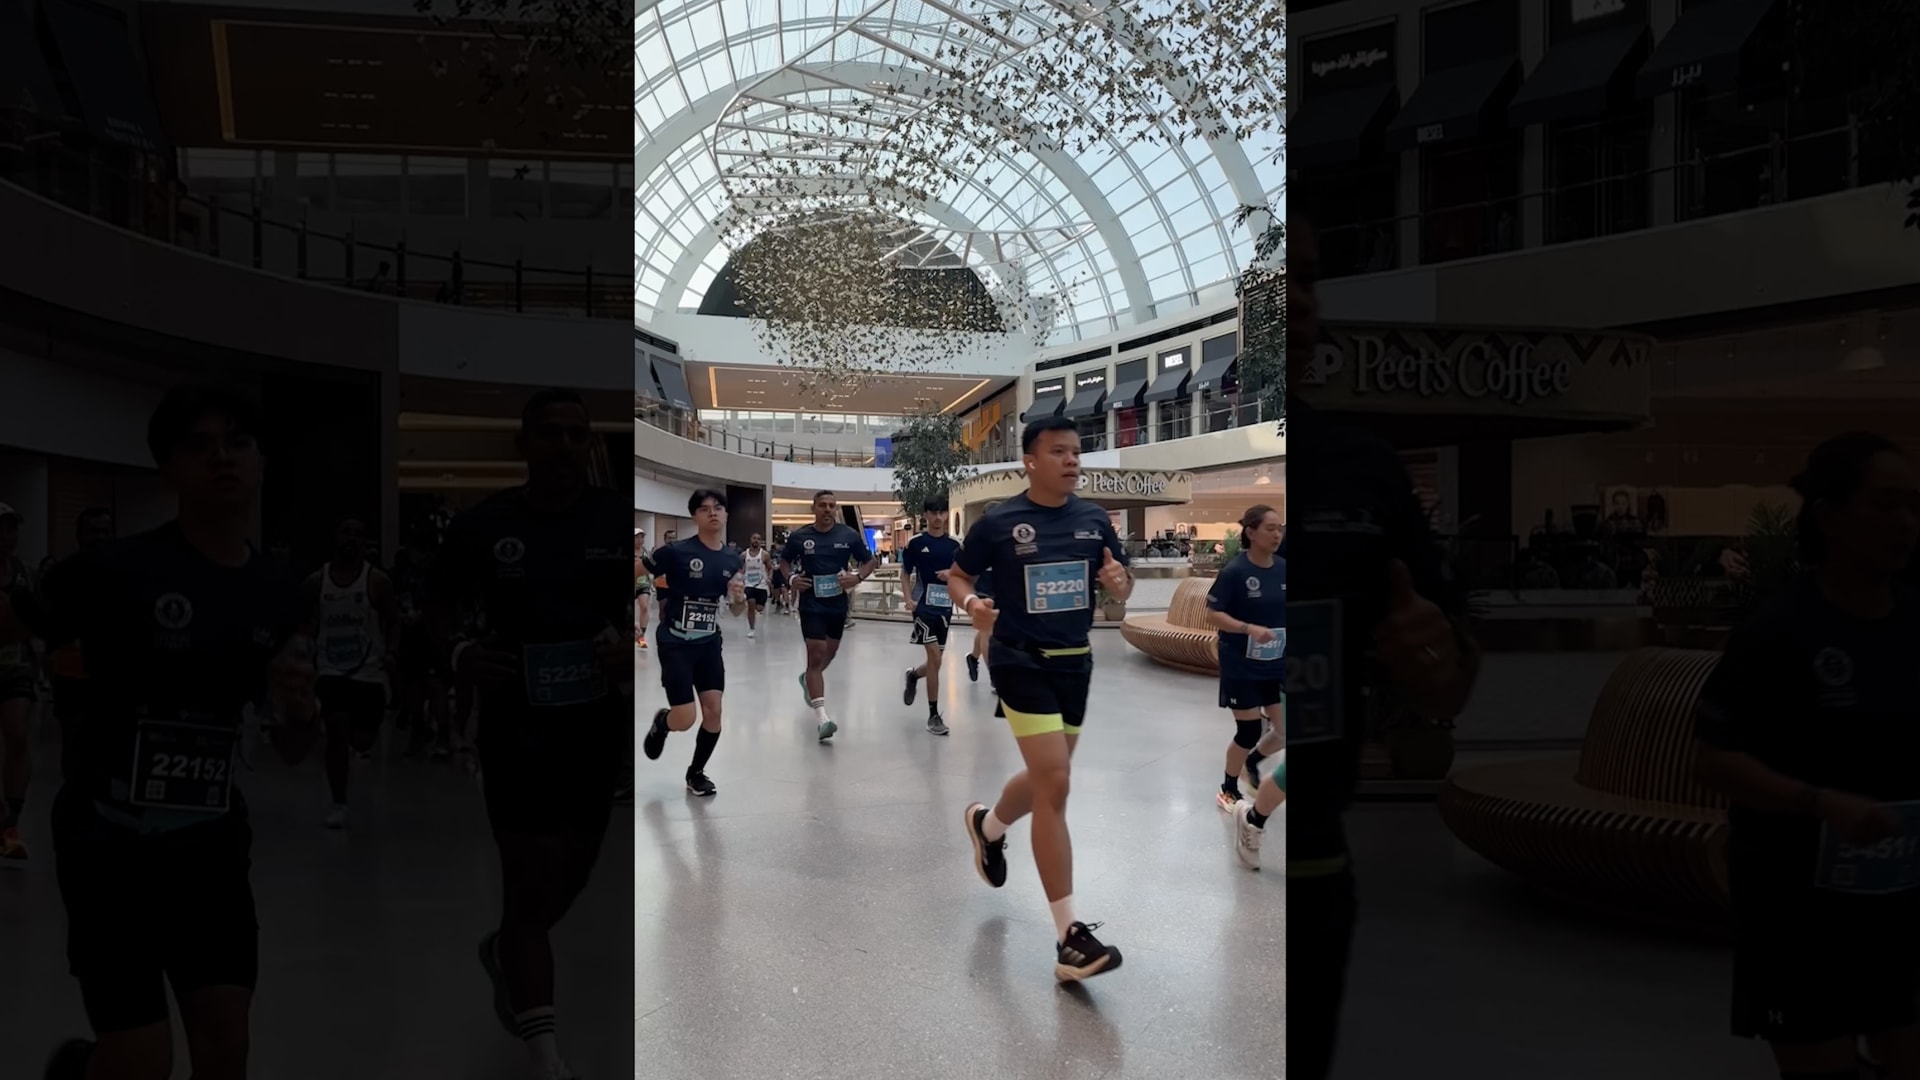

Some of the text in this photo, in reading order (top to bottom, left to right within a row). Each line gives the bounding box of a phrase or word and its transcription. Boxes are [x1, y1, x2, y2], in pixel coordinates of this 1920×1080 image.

[1457, 341, 1573, 404] Coffee
[1127, 474, 1166, 496] Coffee
[1036, 579, 1084, 595] 52220
[689, 612, 715, 623] 22152
[151, 752, 226, 781] 22152
